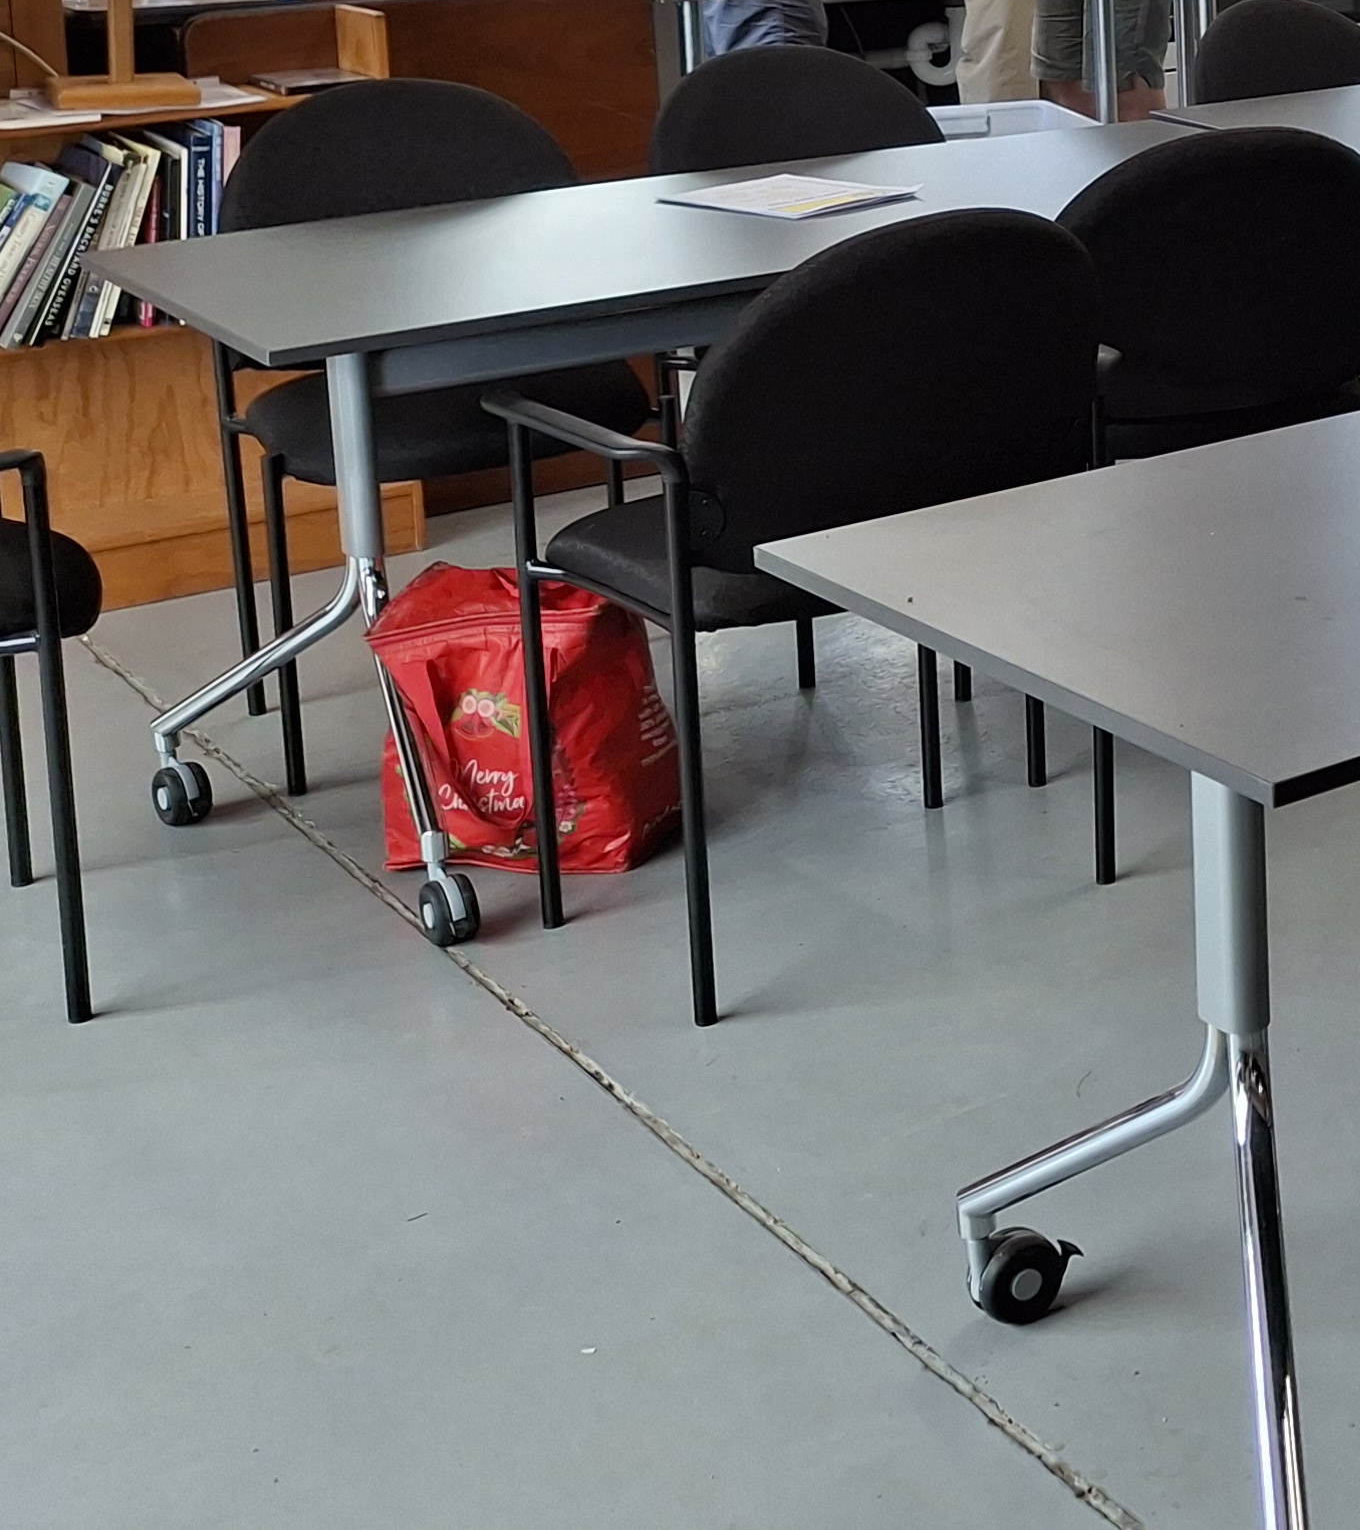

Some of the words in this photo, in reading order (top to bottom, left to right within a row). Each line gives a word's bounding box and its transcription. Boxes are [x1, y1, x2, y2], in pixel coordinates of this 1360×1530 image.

[197, 157, 206, 178] THE
[90, 183, 114, 225] BURKE'S
[196, 179, 206, 221] HISTORY
[44, 278, 72, 327] OVERSEAS
[449, 758, 520, 797] Merry
[438, 783, 526, 815] Chrstma
